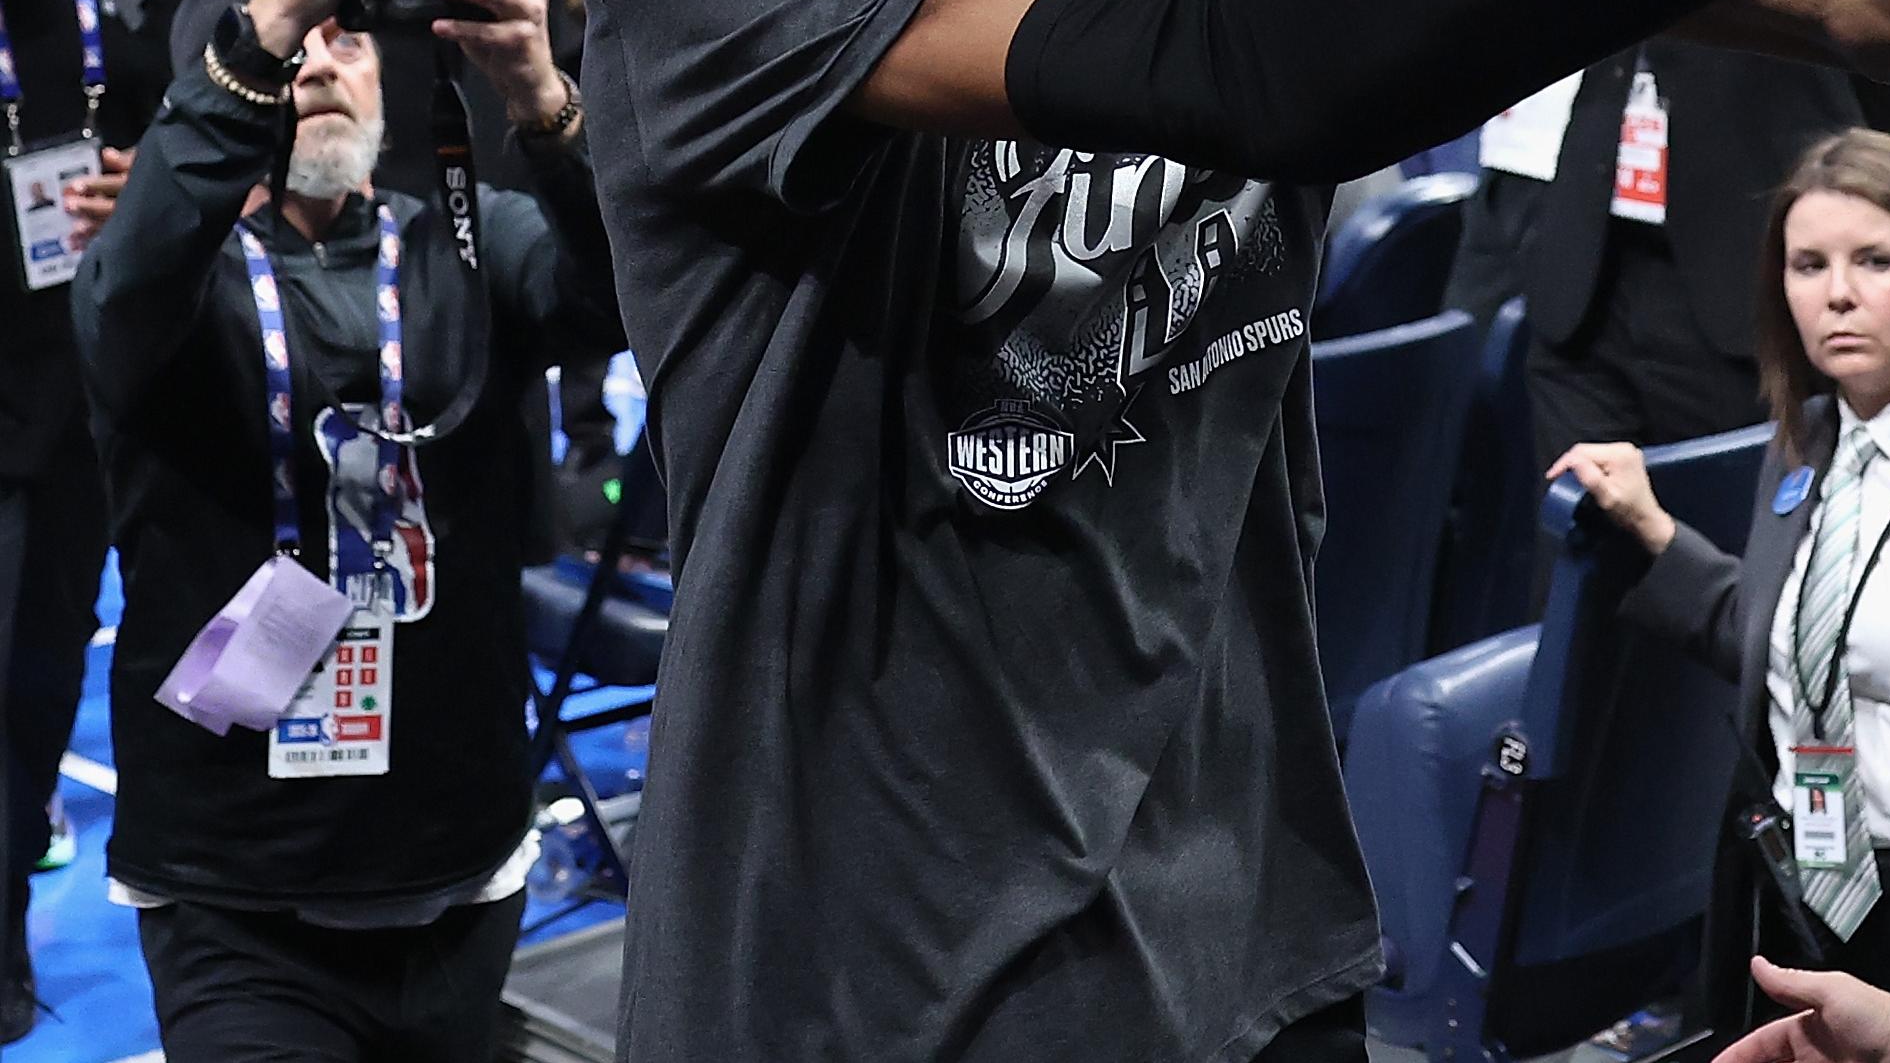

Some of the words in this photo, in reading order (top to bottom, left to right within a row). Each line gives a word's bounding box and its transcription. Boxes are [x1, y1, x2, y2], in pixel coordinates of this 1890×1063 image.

[445, 166, 478, 270] SONY
[1168, 360, 1202, 395] SAN
[1243, 308, 1305, 352] SPURS
[956, 426, 1064, 478] WESTERN
[972, 479, 1048, 504] CONFERENCE
